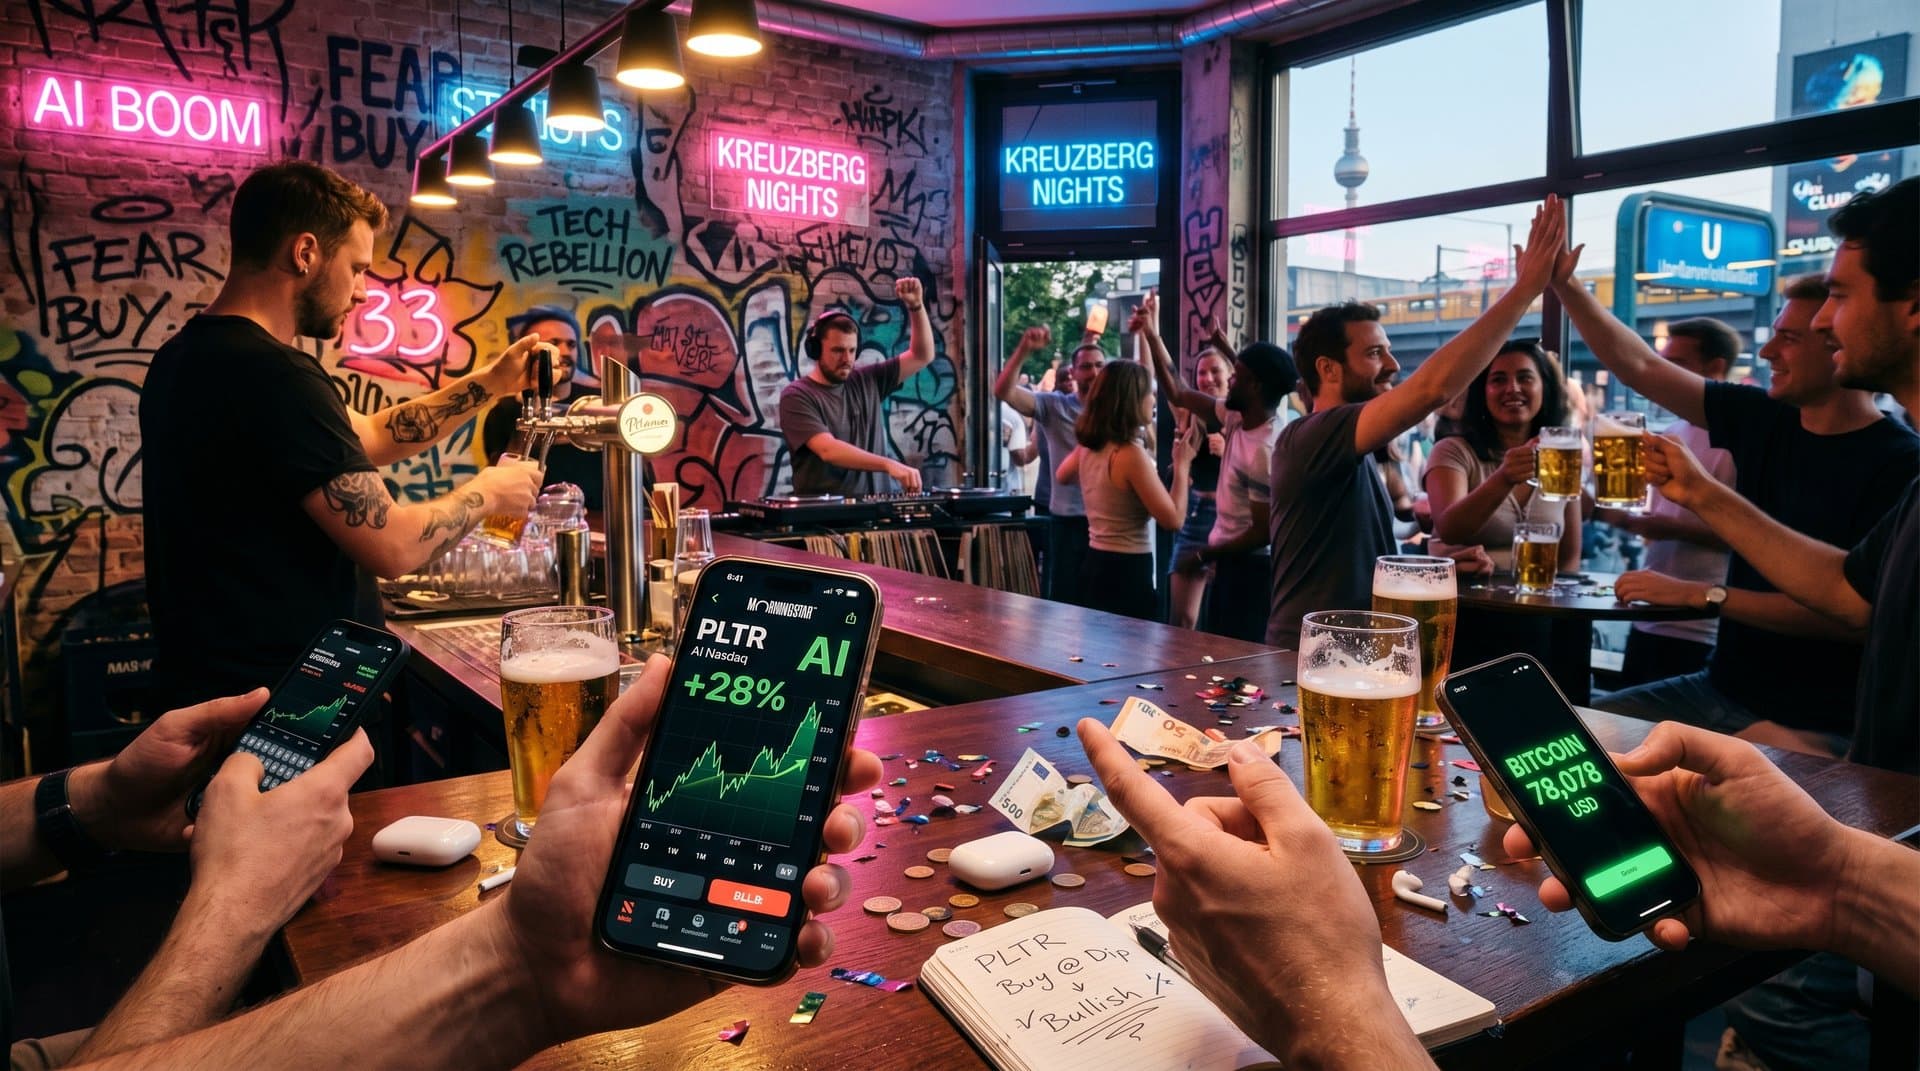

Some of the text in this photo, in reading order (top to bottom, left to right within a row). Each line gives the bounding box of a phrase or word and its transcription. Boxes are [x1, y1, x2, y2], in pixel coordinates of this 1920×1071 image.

[33, 77, 261, 146] AI BOOM
[330, 104, 429, 173] BUY
[1005, 141, 1154, 174] KREUZBERG
[717, 136, 866, 185] KREUZBERG
[747, 178, 839, 218] NIGHTS
[1033, 175, 1125, 206] NIGHTS
[537, 204, 631, 243] TECH
[1702, 221, 1723, 260] U
[50, 231, 226, 292] FEAR
[501, 240, 674, 288] REBELLION
[48, 291, 172, 348] BUY
[350, 288, 444, 356] 33
[696, 617, 767, 650] PLTR
[705, 647, 748, 666] Nasdaq
[797, 636, 850, 677] AI
[684, 671, 786, 711] +28%
[1504, 733, 1587, 779] BITCOIN
[1526, 760, 1603, 806] 78,078
[1001, 797, 1024, 820] 500
[1567, 796, 1599, 818] USD
[639, 842, 650, 851] 1D
[696, 852, 707, 861] 1M
[753, 863, 764, 871] 1Y
[653, 875, 676, 889] BUY
[975, 933, 1067, 974] PLTR
[996, 947, 1131, 996] Buy @ Dip
[1039, 986, 1143, 1033] Bullish
